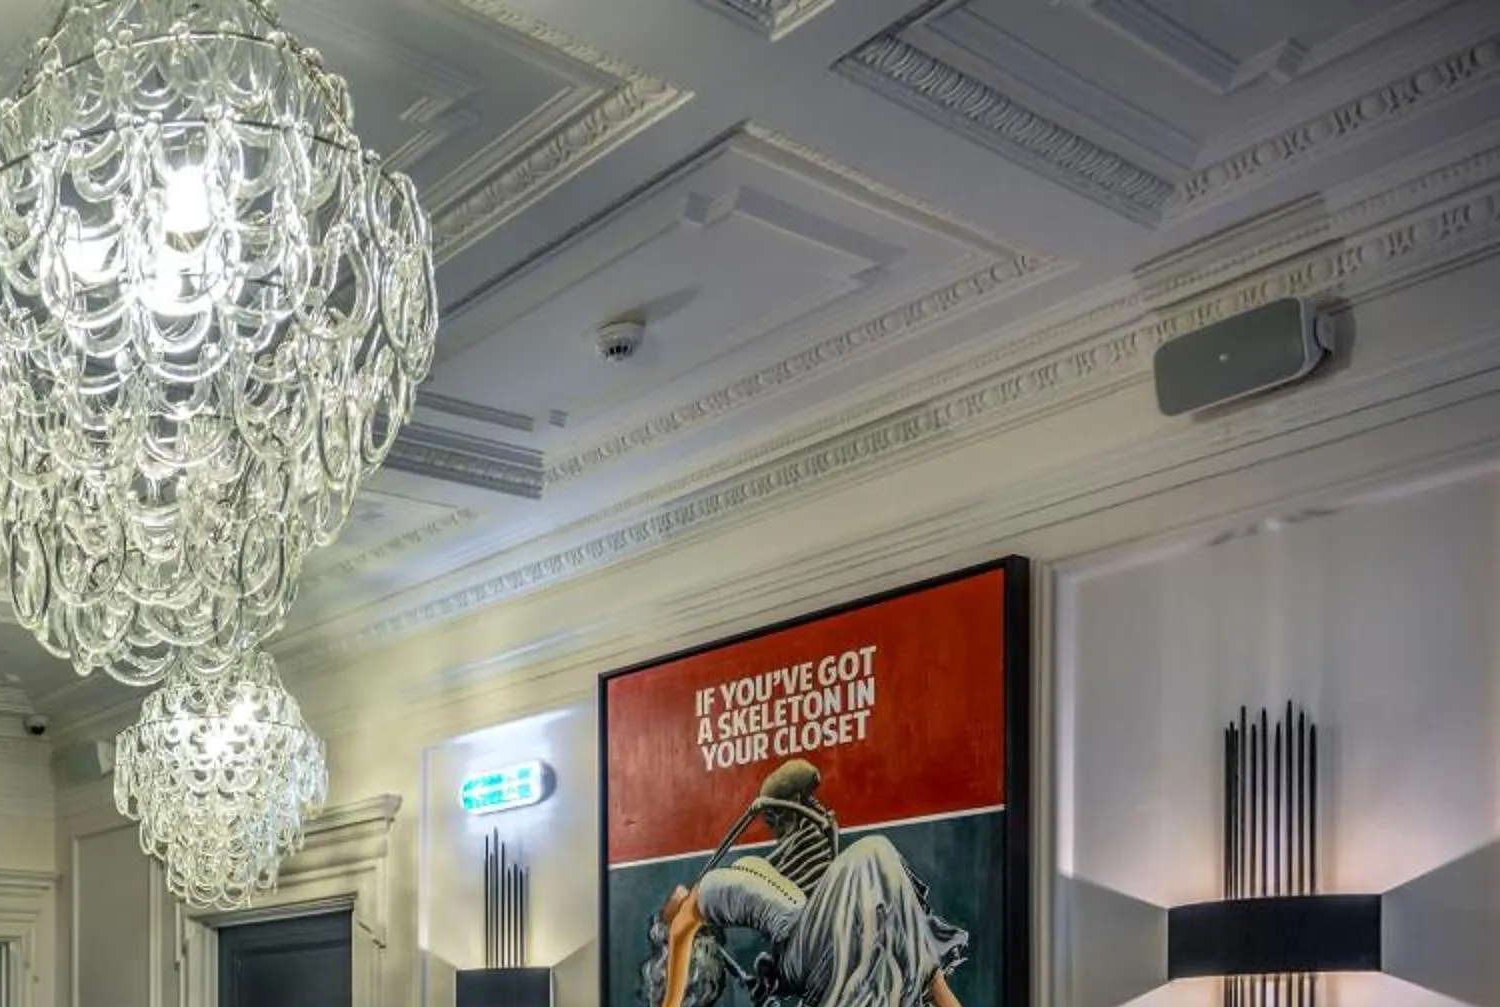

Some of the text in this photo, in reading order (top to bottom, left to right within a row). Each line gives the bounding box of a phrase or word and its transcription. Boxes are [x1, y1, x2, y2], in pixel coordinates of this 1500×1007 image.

[695, 645, 877, 717] IF YOU'VE GOT
[697, 677, 875, 745] A SKELETON IN
[701, 709, 871, 771] YOUR CLOSET
